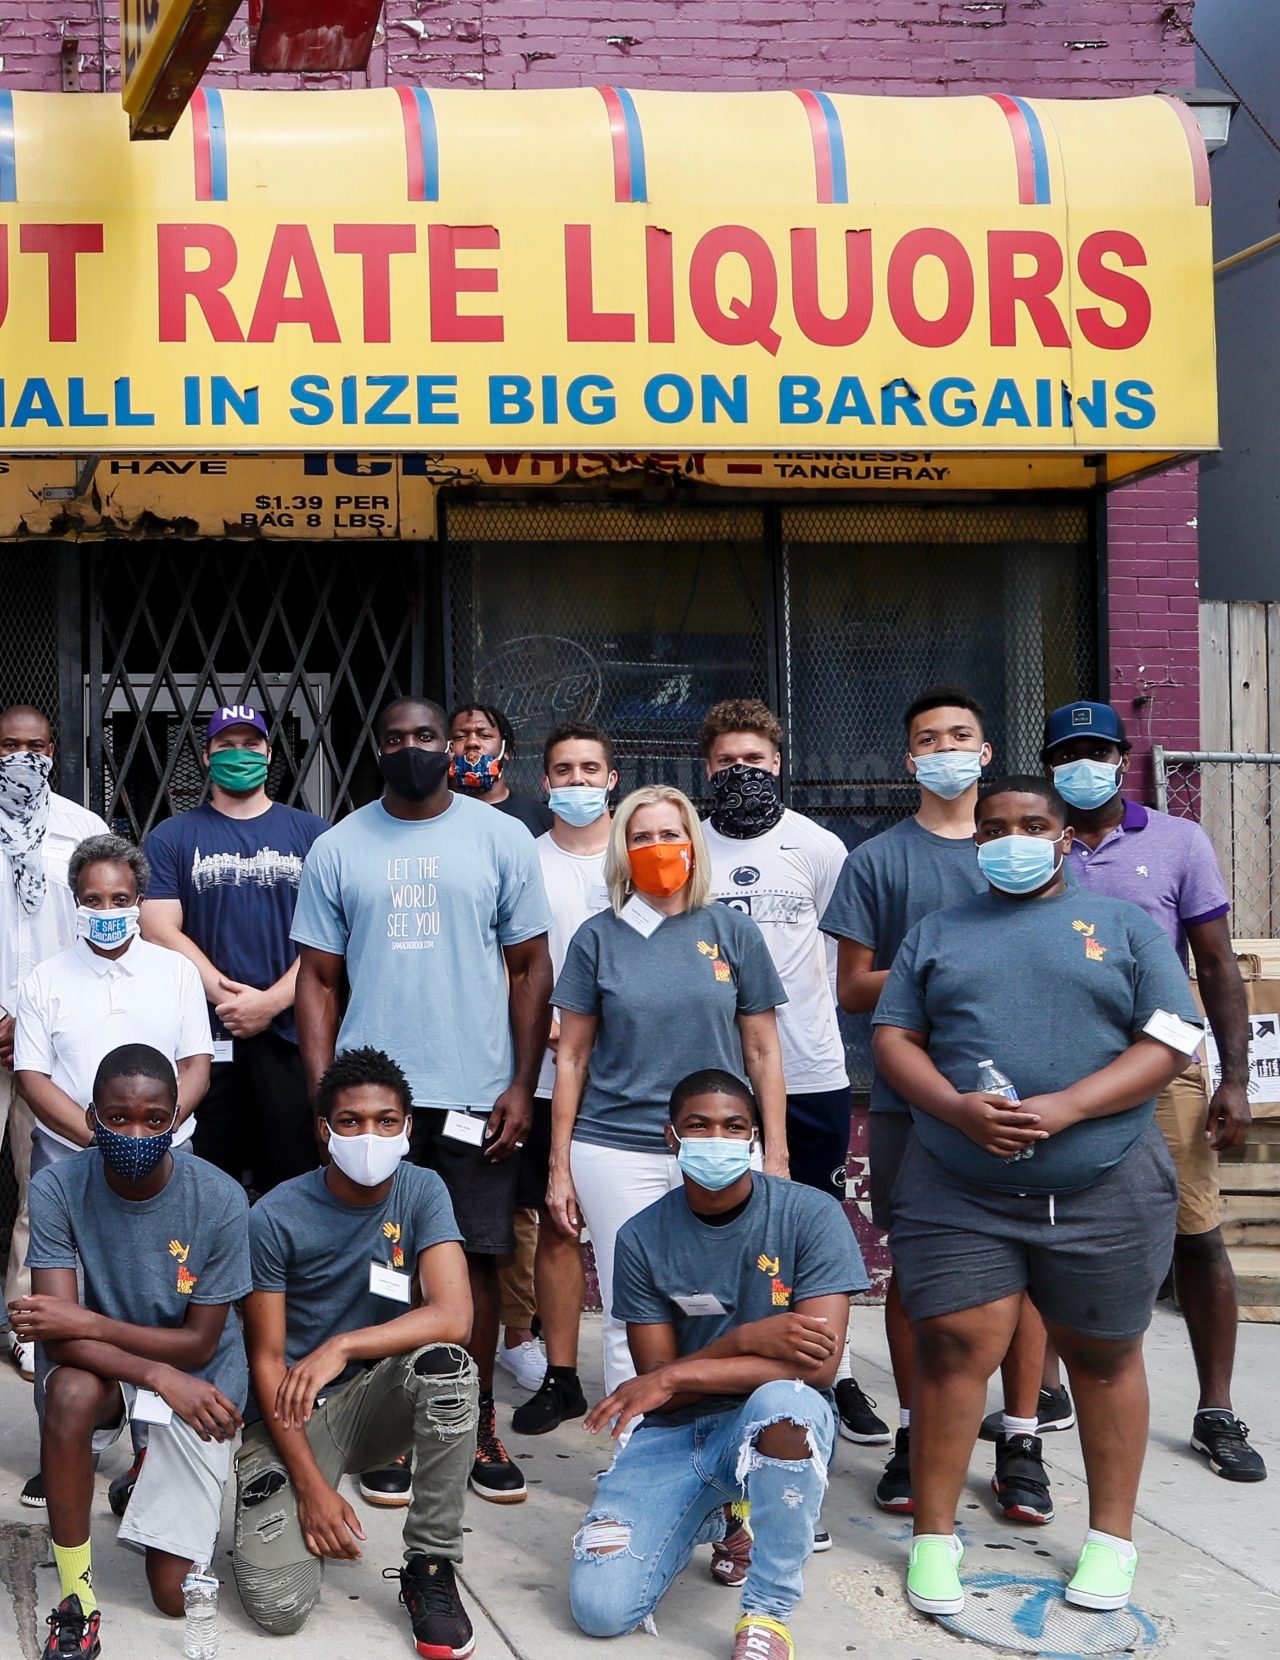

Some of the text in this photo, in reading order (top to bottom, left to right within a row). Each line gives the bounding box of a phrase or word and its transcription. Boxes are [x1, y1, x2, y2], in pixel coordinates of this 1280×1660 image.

[157, 223, 505, 343] RATE
[564, 224, 1152, 356] LIQUORS
[184, 375, 259, 425] IN
[289, 374, 460, 425] SIZE
[488, 375, 617, 425] BIG
[643, 374, 748, 425] ON
[778, 375, 1157, 430] BARGAINS
[111, 461, 227, 475] HAVE
[774, 464, 950, 481] TANGUERAY
[255, 495, 390, 510] $1.39 PER
[241, 513, 392, 529] BAG 8 LBS.
[222, 705, 255, 720] NU
[387, 856, 440, 880] LET THE
[390, 883, 437, 908] WORLD
[102, 919, 122, 933] SAFE
[386, 911, 440, 937] SEE YOU
[715, 1560, 734, 1574] B
